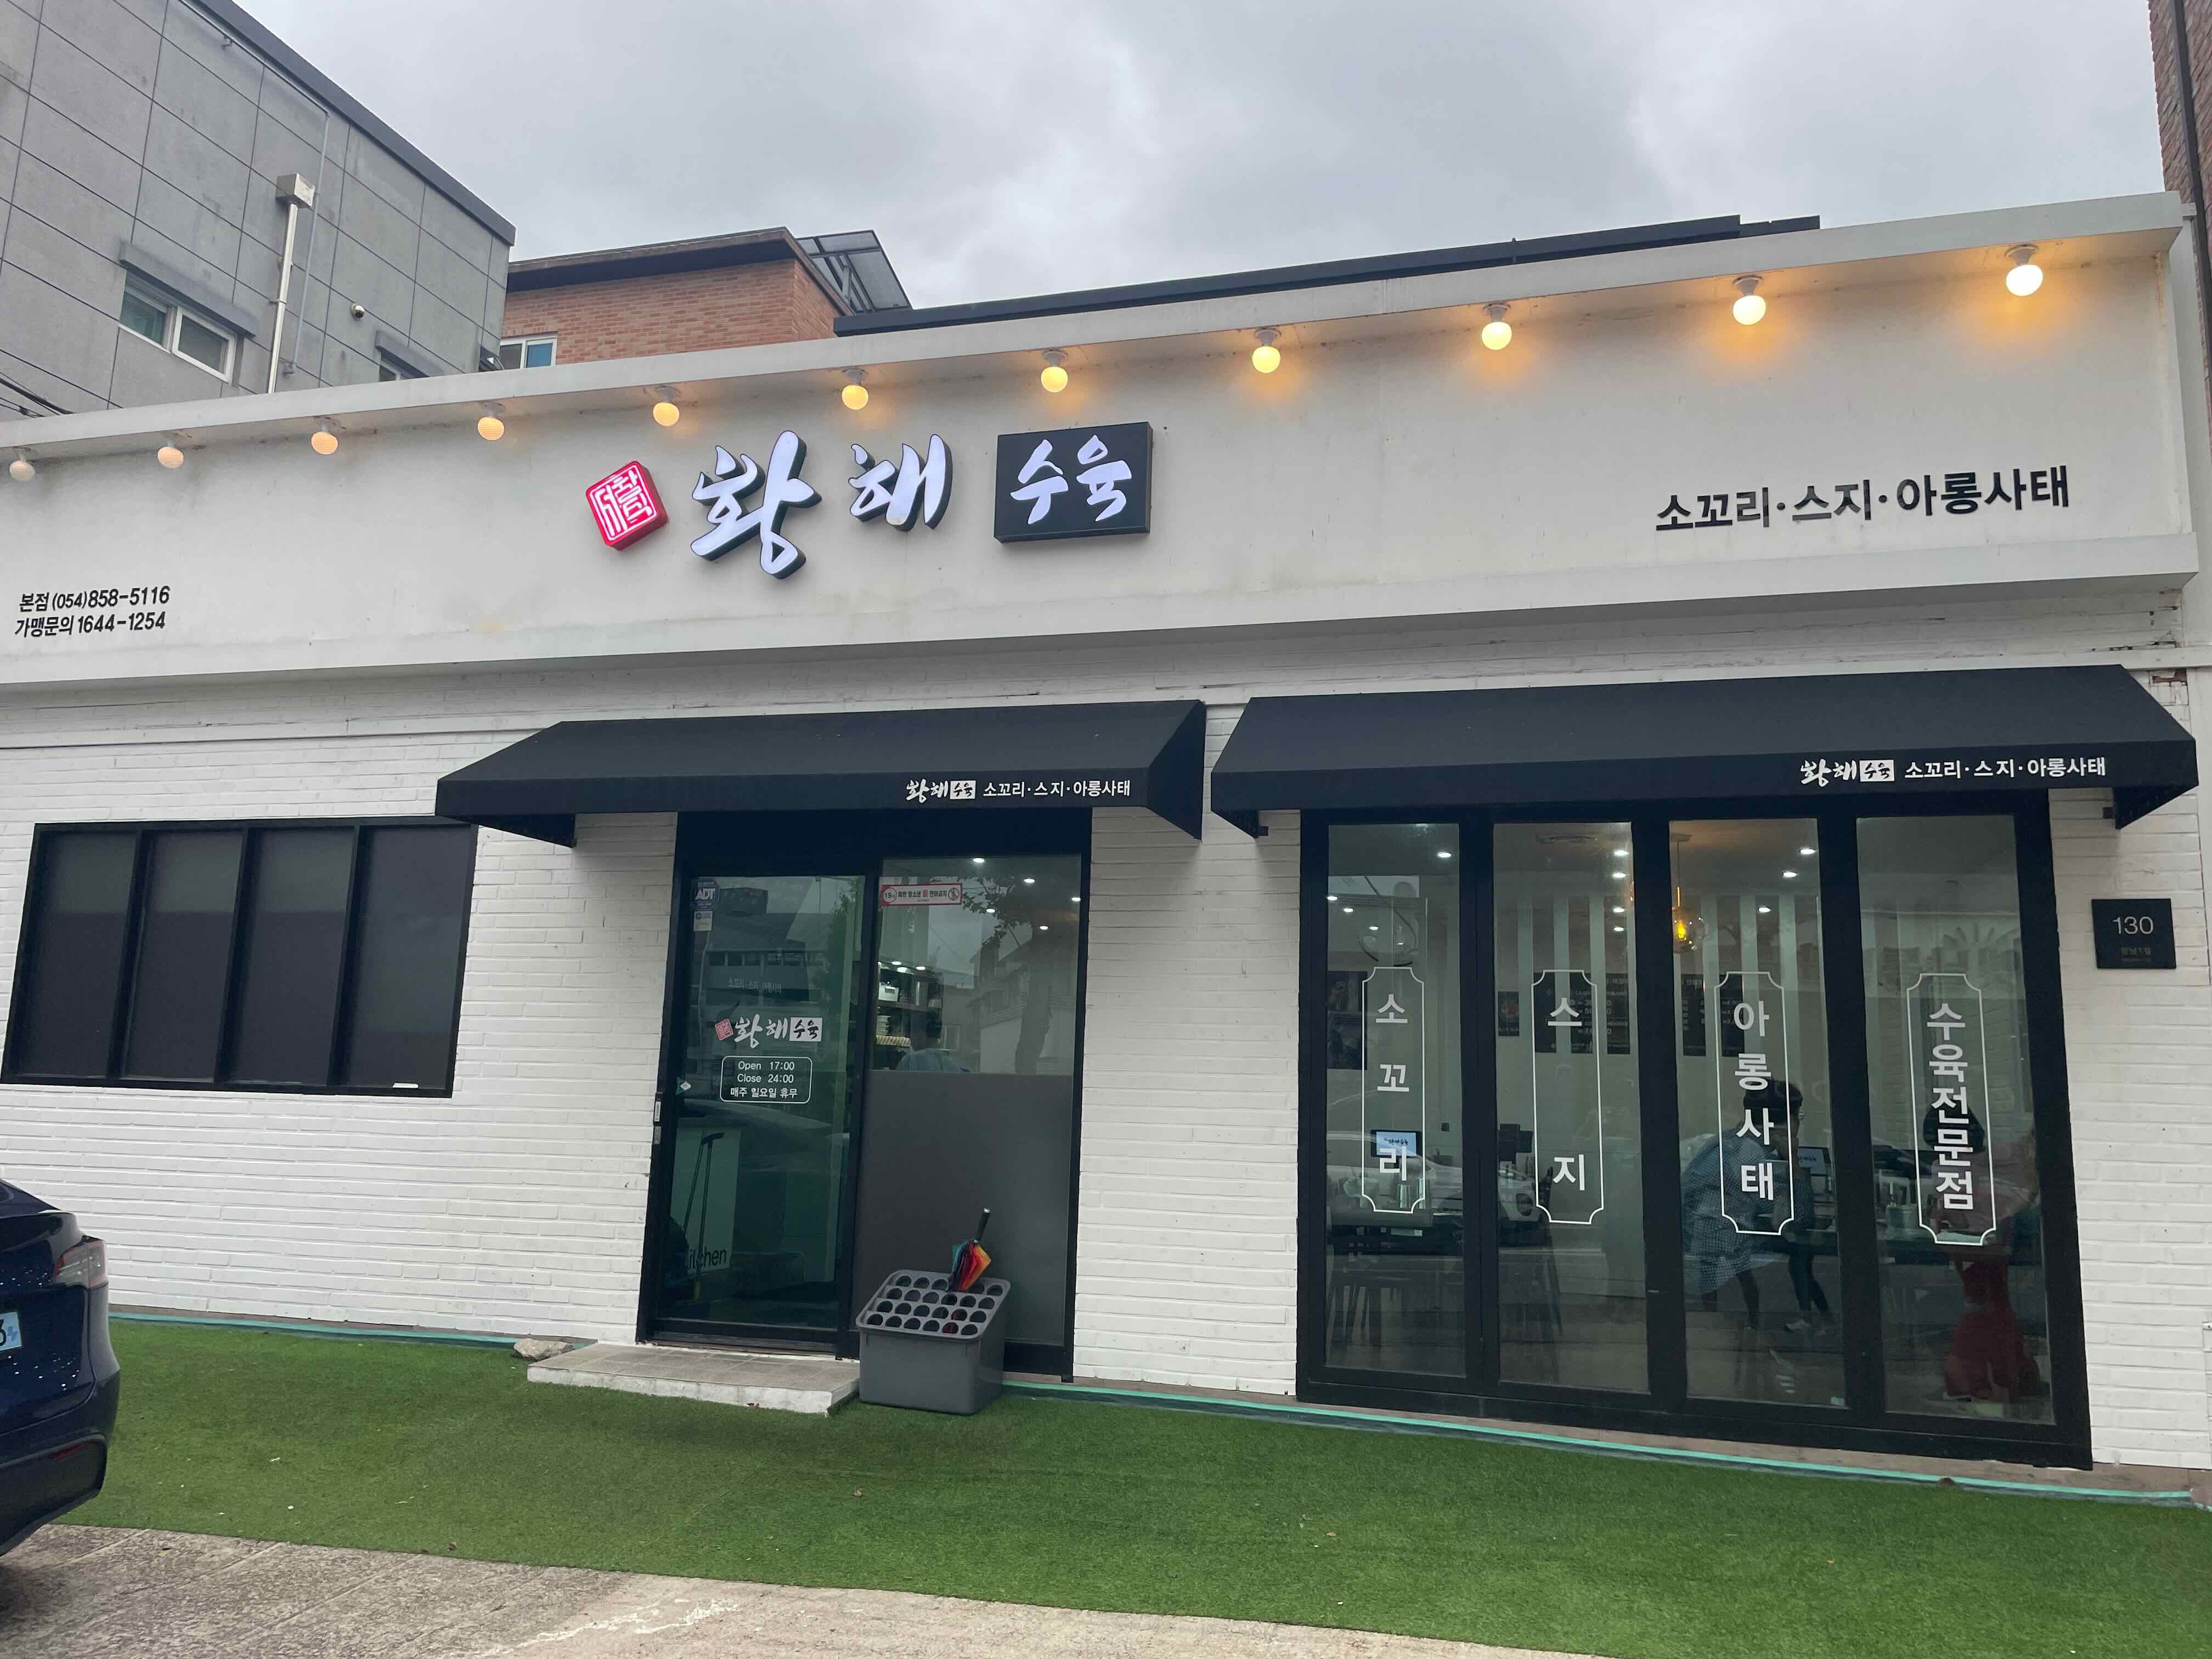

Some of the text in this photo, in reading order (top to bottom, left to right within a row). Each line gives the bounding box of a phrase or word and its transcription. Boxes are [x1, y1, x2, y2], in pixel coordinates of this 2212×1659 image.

[1010, 435, 1133, 524] 수육
[19, 585, 171, 612] 본점 (054)858-5116
[15, 611, 166, 637] 가맹문의 1644-1254
[695, 888, 716, 900] ADT
[2112, 916, 2154, 935] 130
[793, 1019, 820, 1040] 수육
[737, 1074, 794, 1083] Close 24:00
[738, 1061, 795, 1071] Open 17:00
[730, 1087, 798, 1099] 매주 일요일 휴무
[1375, 993, 1410, 1181] 소꼬리
[1547, 997, 1585, 1191] 스지
[1733, 1000, 1774, 1201] 아롱사태
[1926, 1002, 1974, 1210] 수육전문점
